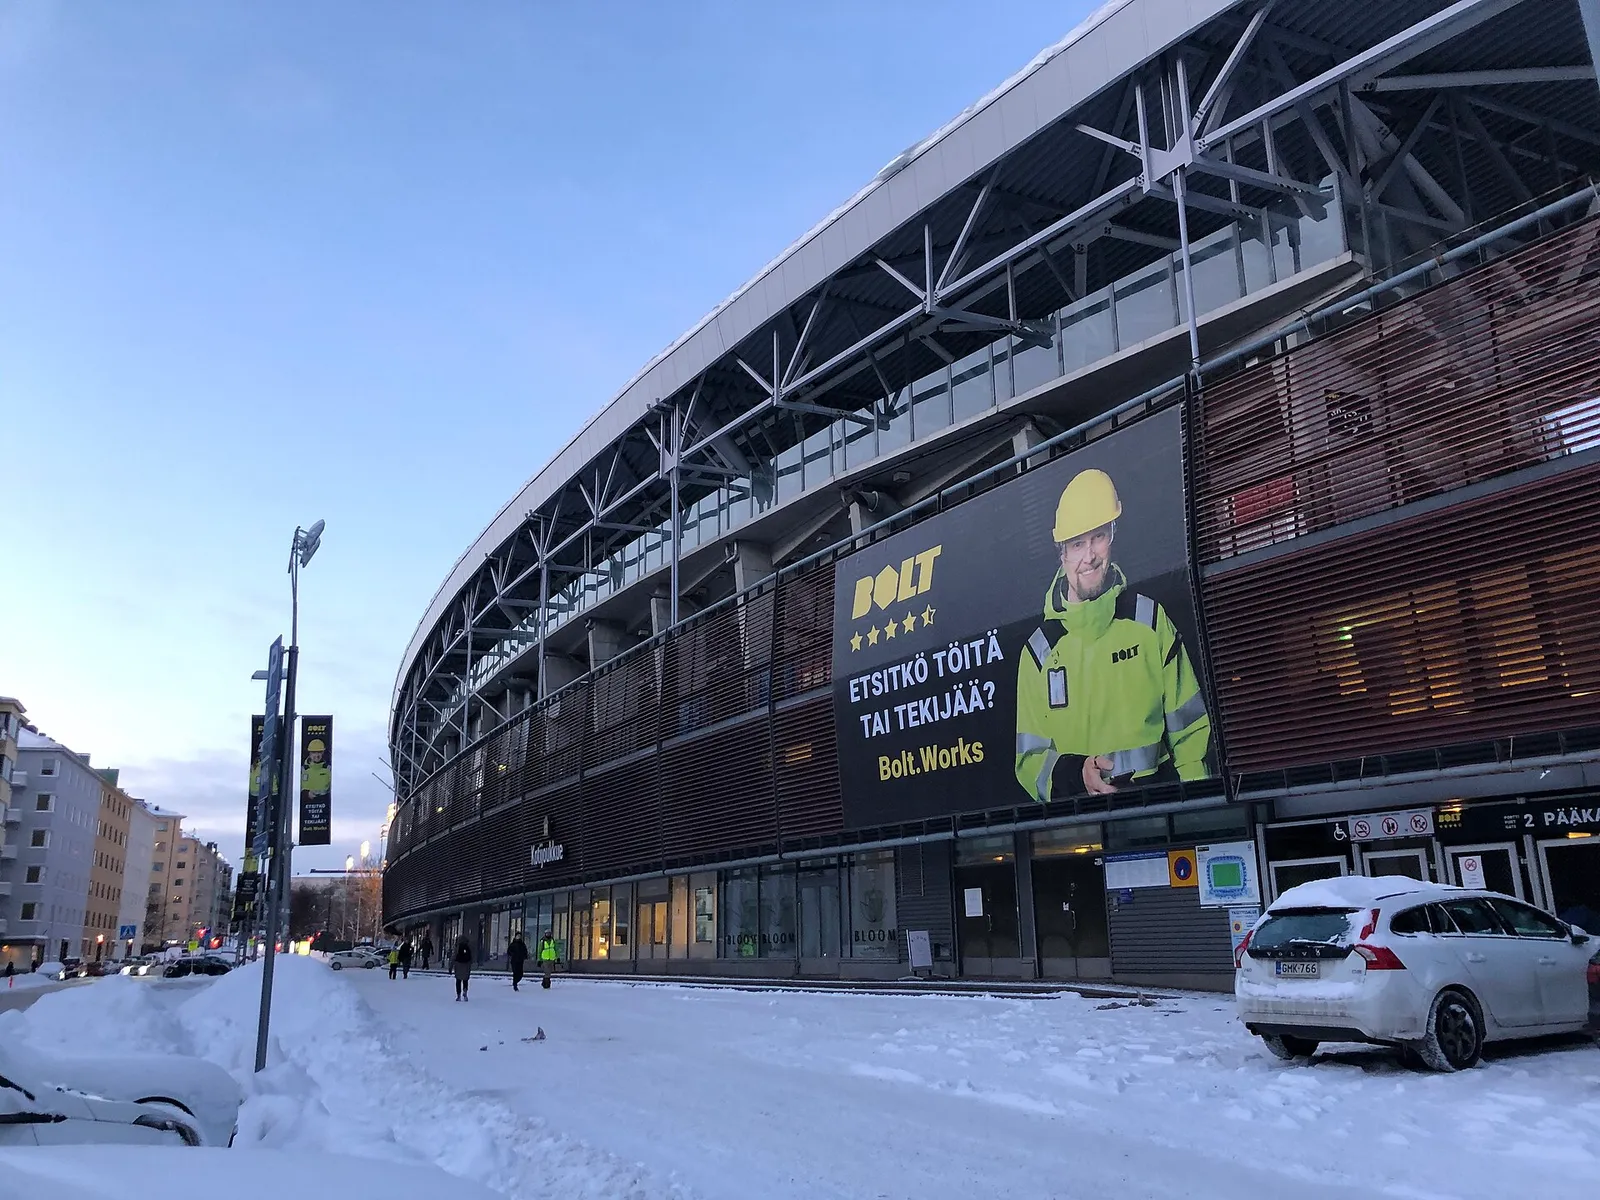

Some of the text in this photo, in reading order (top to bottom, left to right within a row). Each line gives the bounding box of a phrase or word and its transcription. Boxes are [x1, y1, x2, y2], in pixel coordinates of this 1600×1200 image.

[852, 545, 942, 620] BOLT
[1111, 644, 1140, 664] BOLT
[849, 629, 1004, 703] ETSITKÖ TÖITÄ
[860, 678, 996, 738] TAI TEKIJÄÄ?
[878, 737, 985, 781] Bolt.Works
[1438, 812, 1462, 823] BOLT
[1523, 813, 1535, 828] 2
[762, 933, 795, 943] BLOOM
[854, 928, 897, 943] BLOOM
[1282, 963, 1317, 973] GMK-766
